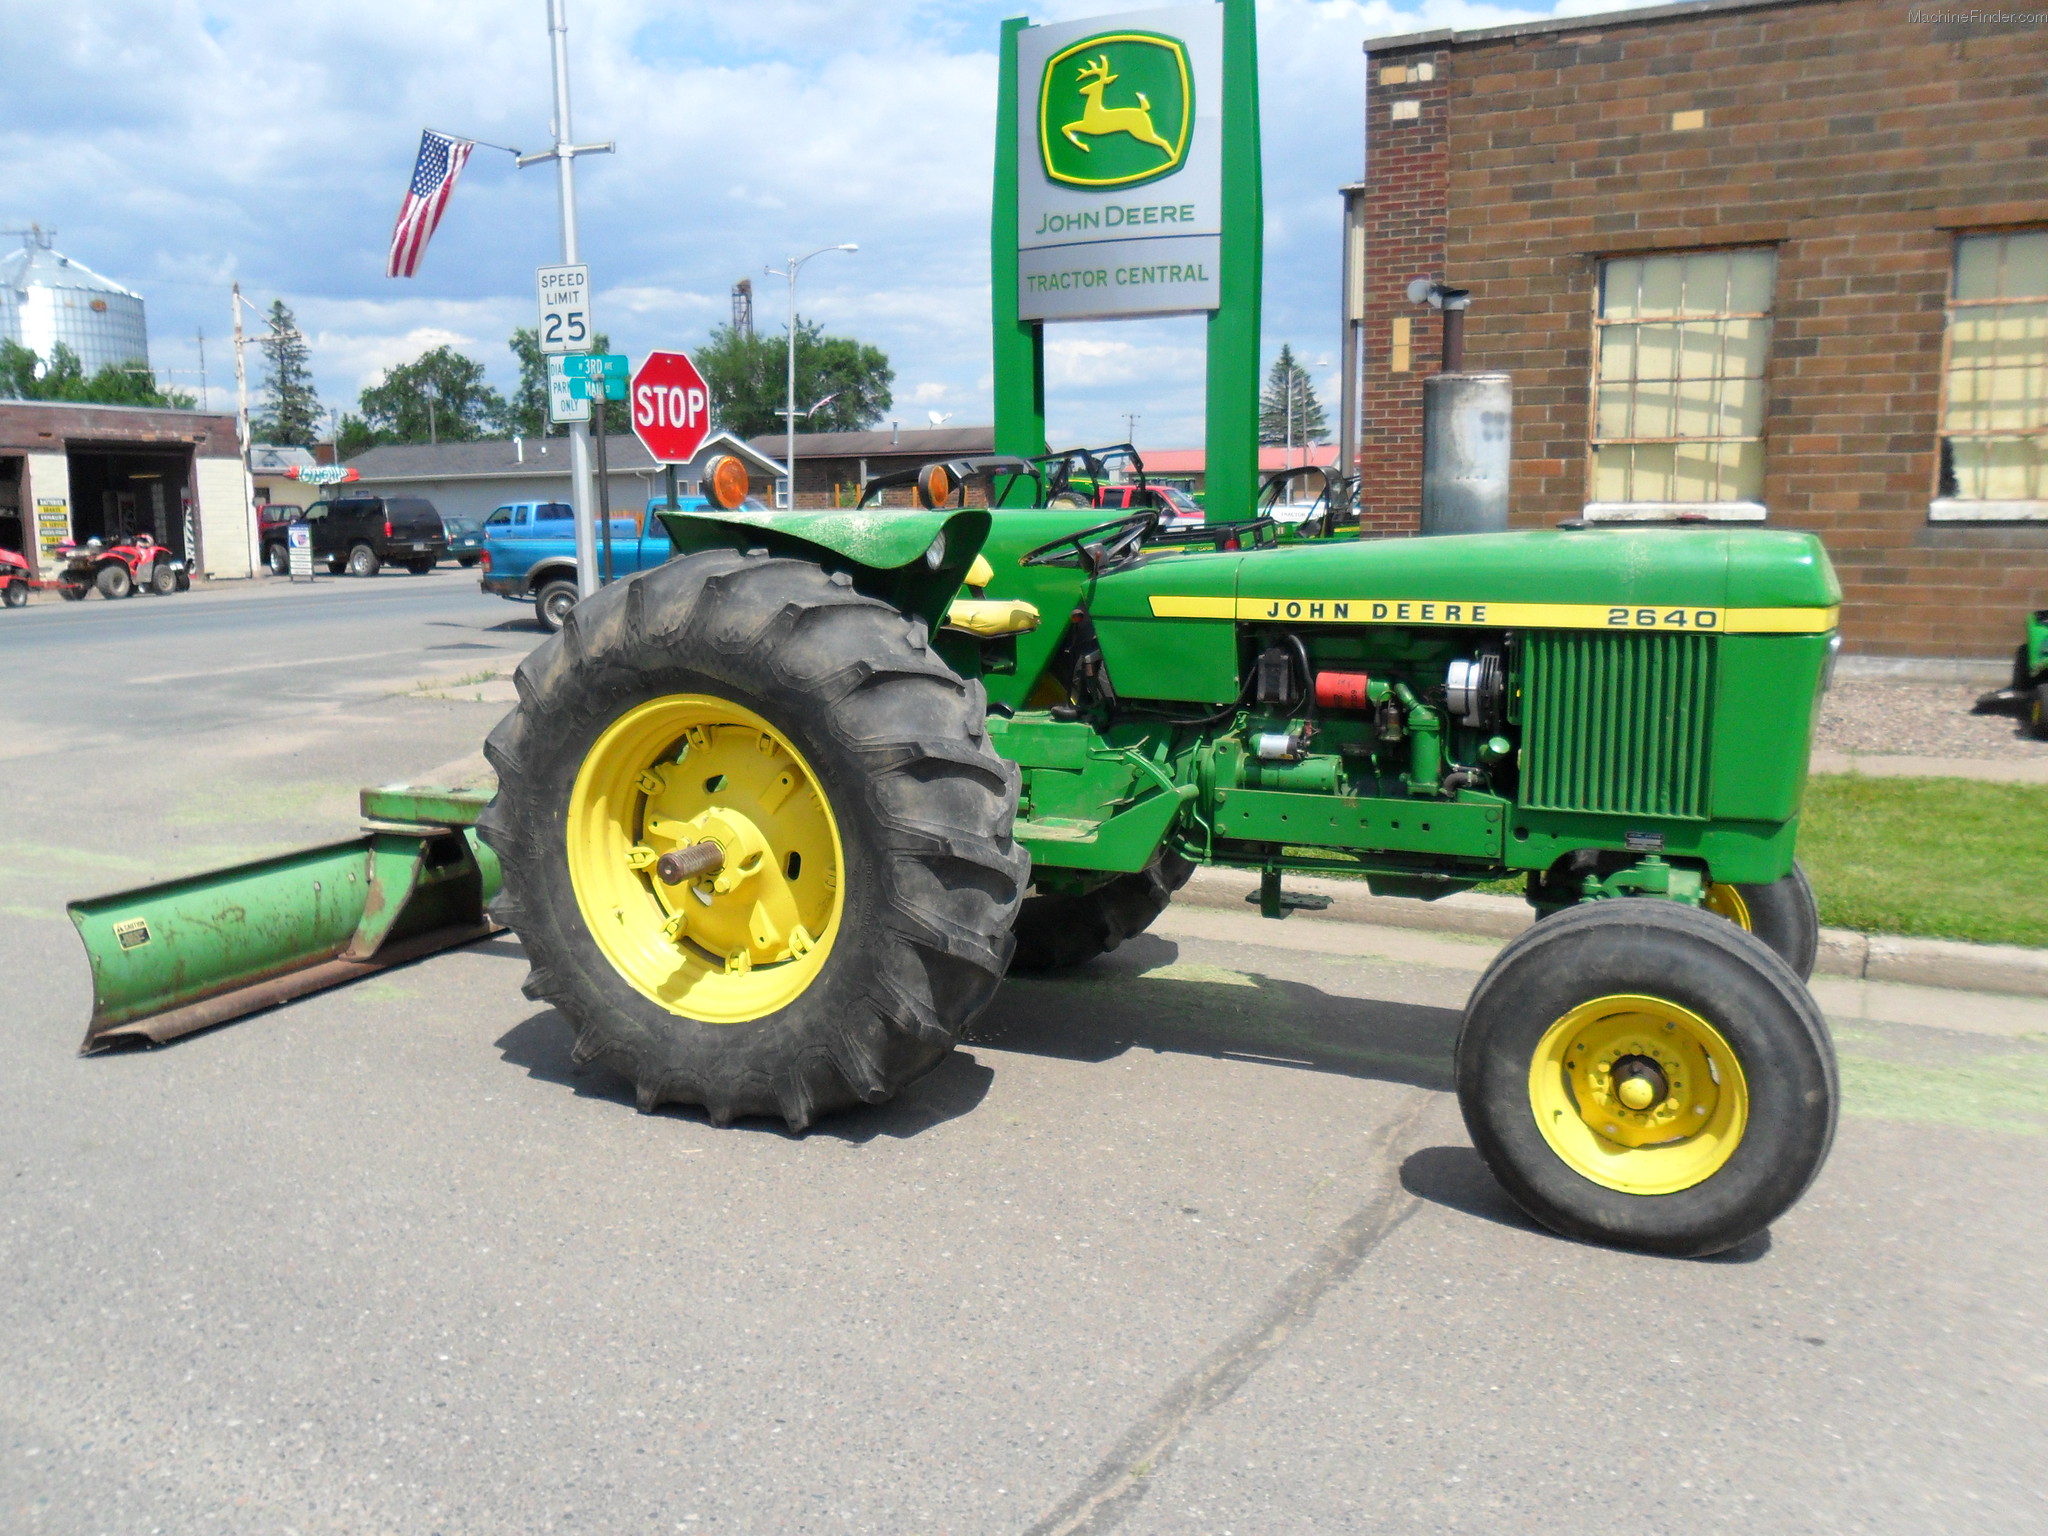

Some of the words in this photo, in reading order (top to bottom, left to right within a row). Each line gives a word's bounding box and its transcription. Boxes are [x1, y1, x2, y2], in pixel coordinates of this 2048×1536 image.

[541, 273, 585, 288] SPEED
[1027, 269, 1108, 293] TRACTOR
[1115, 264, 1209, 286] CENTRAL
[546, 291, 579, 305] LIMIT
[544, 312, 586, 343] 25
[585, 359, 602, 374] 3RD
[561, 400, 578, 412] ONLY
[637, 385, 705, 429] STOP
[1266, 602, 1349, 619] JOHN
[1371, 603, 1487, 622] DEERE
[1607, 608, 1718, 628] 2640
